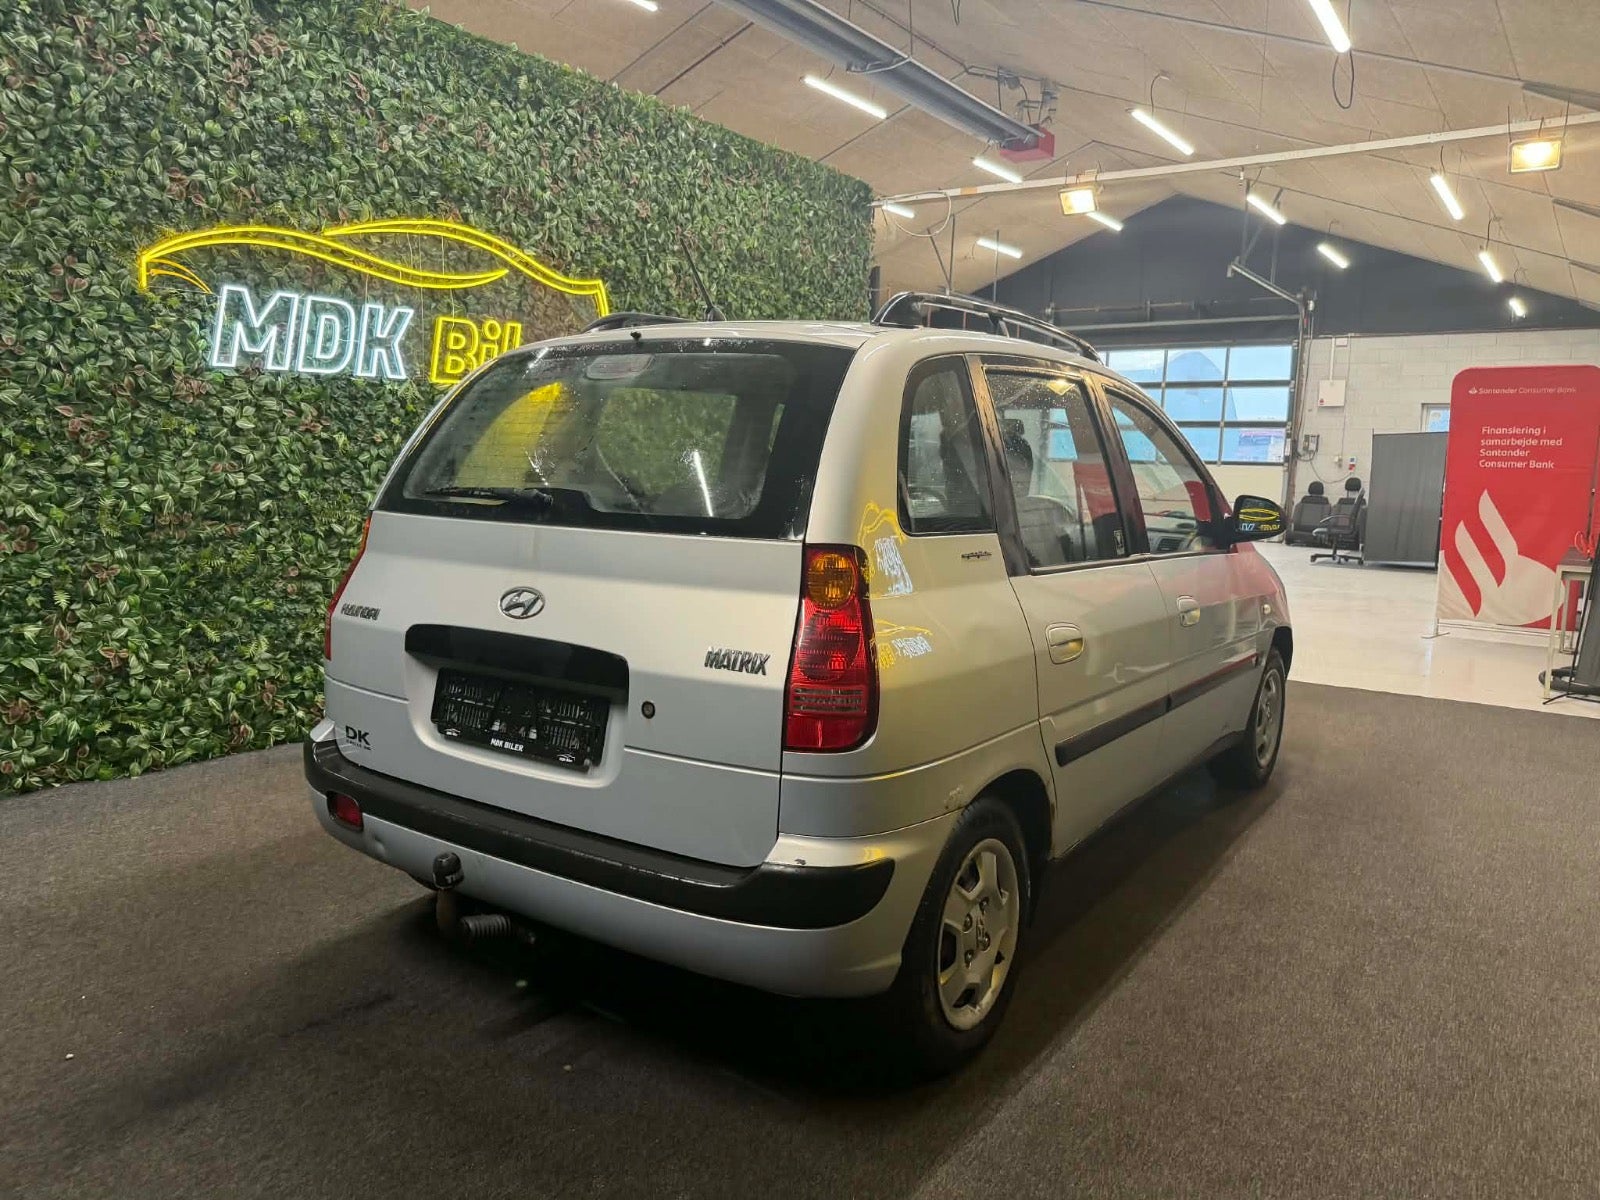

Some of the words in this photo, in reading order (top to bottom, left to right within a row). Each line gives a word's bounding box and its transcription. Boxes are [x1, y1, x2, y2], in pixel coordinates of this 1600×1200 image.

[210, 284, 415, 380] MDK
[1481, 426, 1541, 436] Finansiering
[1480, 438, 1539, 448] samarbejde
[1540, 438, 1563, 446] med
[1480, 448, 1531, 457] Santander
[1479, 459, 1527, 468] Consumer
[1529, 460, 1555, 469] Bank
[704, 647, 771, 676] MATRIX
[345, 725, 370, 746] DK
[503, 741, 524, 752] BILER
